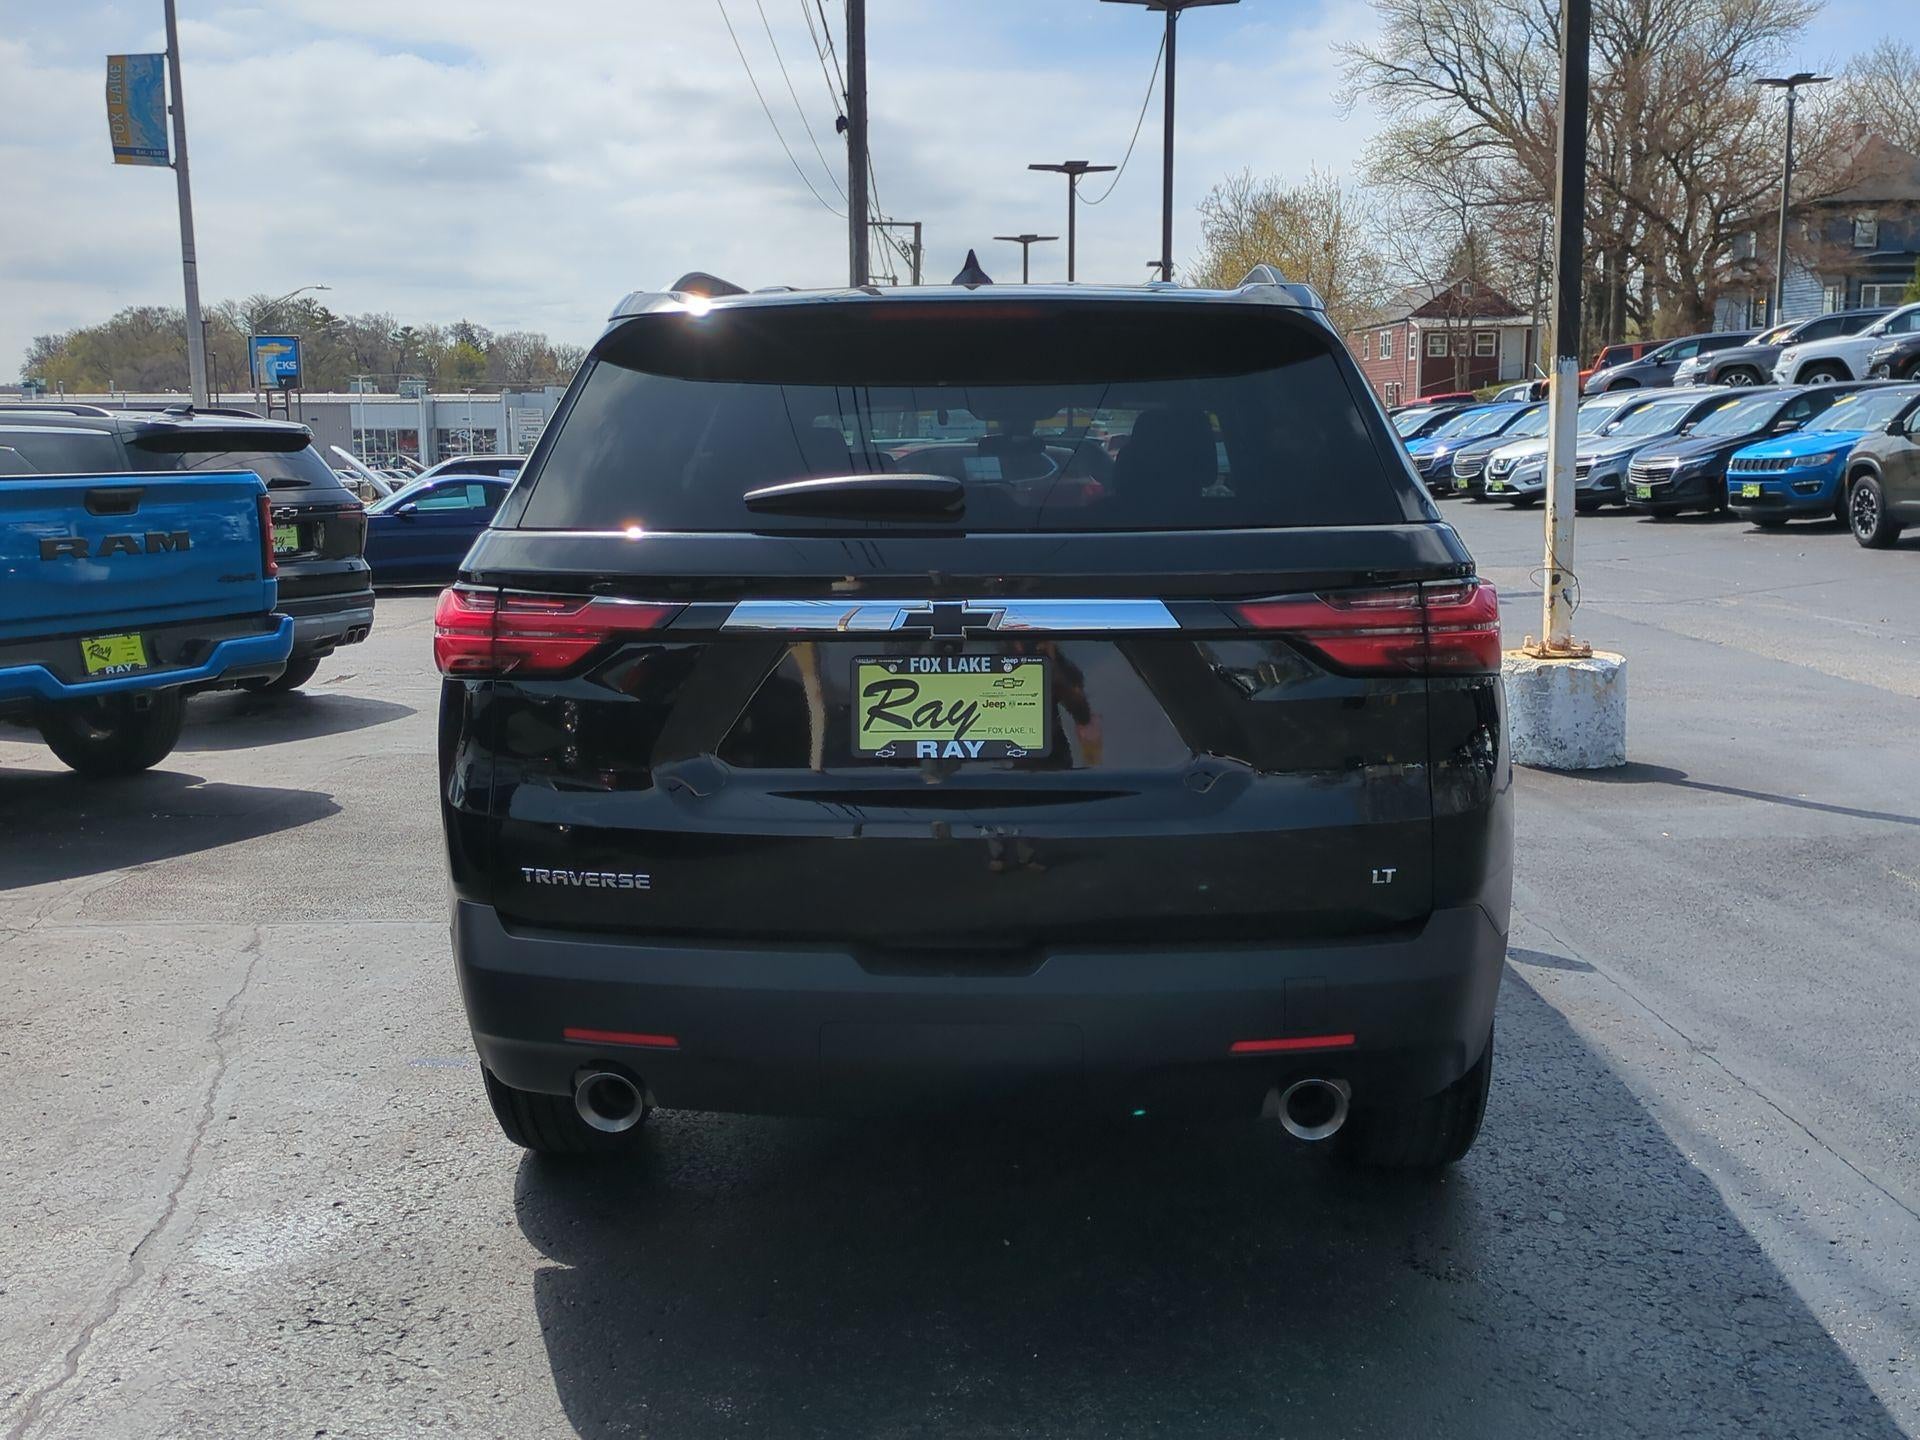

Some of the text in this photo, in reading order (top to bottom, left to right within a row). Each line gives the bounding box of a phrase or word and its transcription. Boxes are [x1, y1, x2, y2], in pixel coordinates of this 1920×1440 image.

[109, 63, 127, 145] FOX LAKE
[39, 530, 191, 561] RAM
[87, 643, 112, 662] Ray
[1001, 657, 1018, 665] Jeep
[105, 663, 132, 674] RAY
[910, 657, 991, 673] FOX LAKE
[862, 678, 981, 740] Ray
[982, 699, 1006, 709] Jeep
[987, 726, 1003, 734] FOX
[916, 740, 985, 758] RAY
[521, 867, 651, 889] TRAVERSE
[1372, 868, 1397, 884] LT
